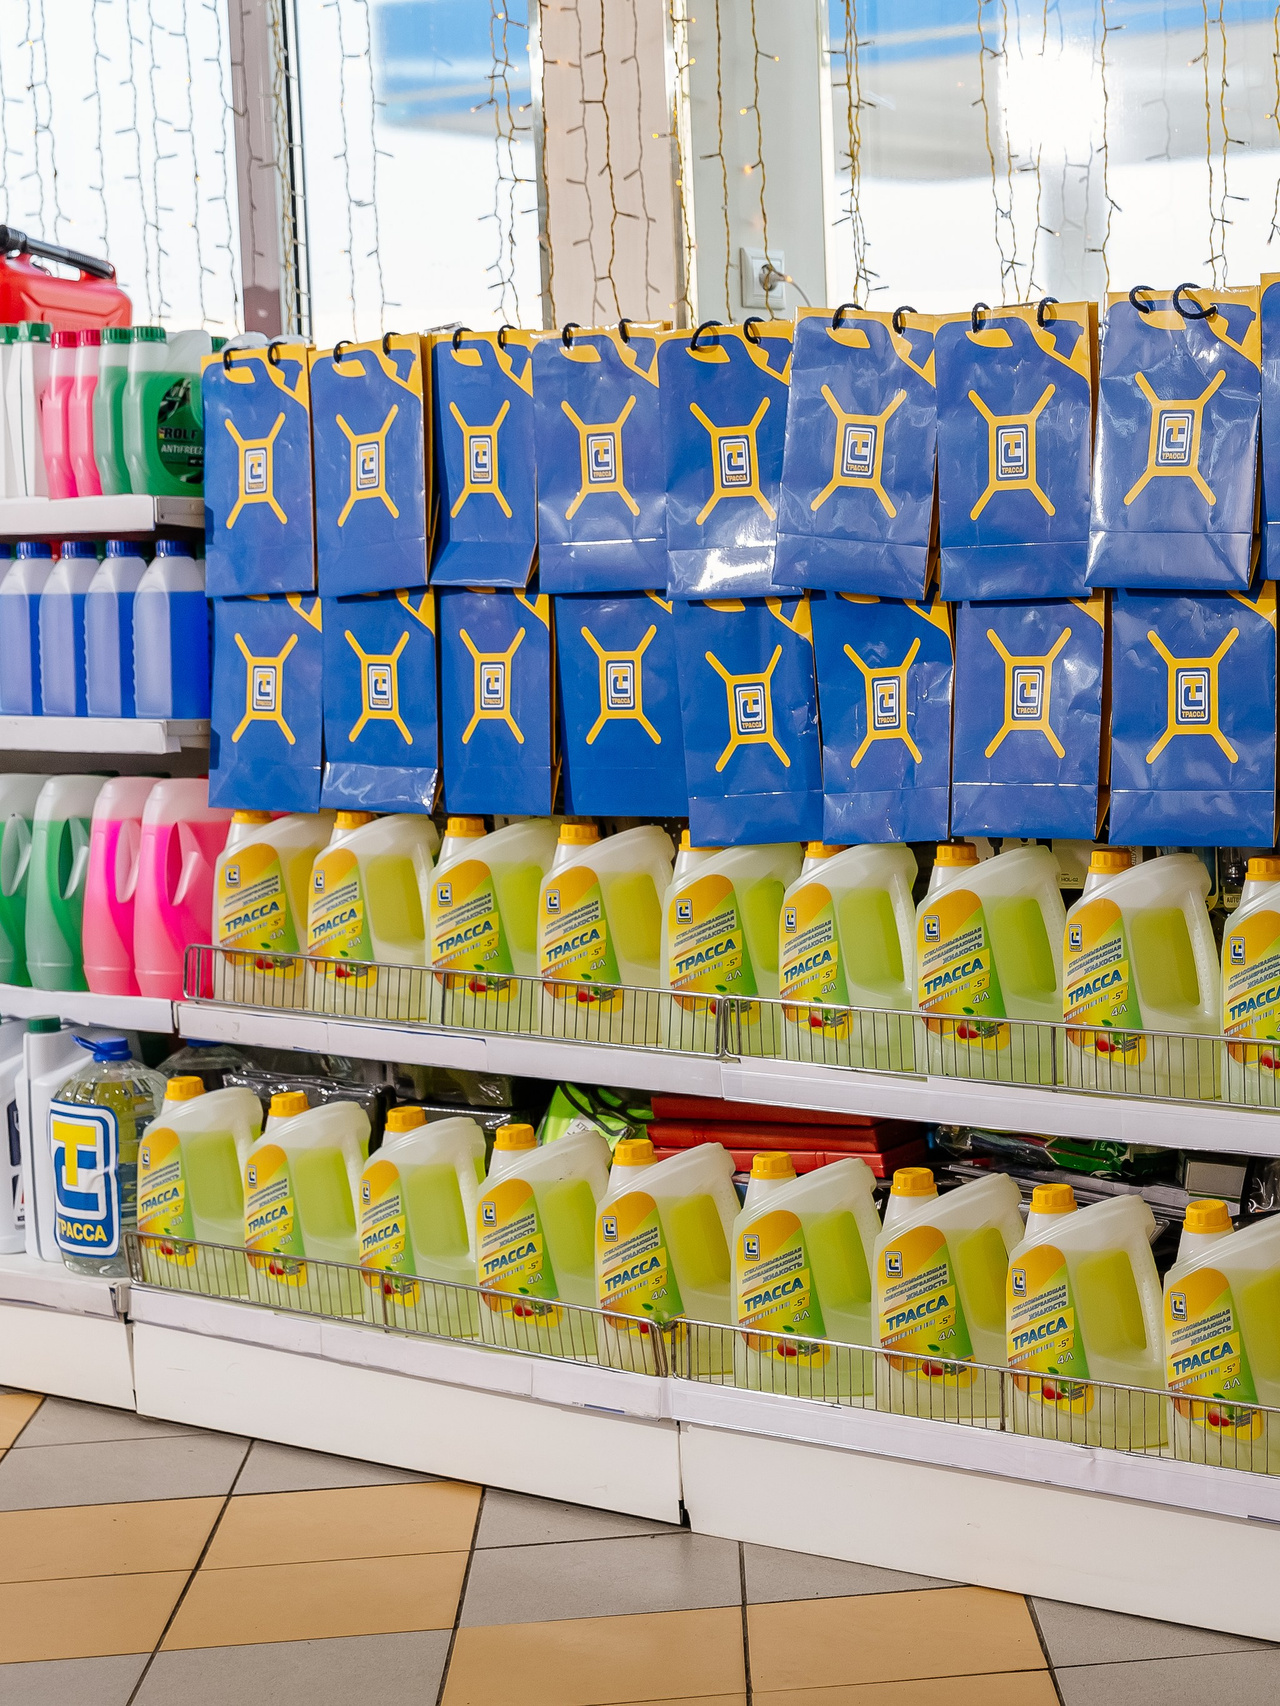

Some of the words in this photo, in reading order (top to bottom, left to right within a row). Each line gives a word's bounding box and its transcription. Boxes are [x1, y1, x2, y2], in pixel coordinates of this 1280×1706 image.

[161, 444, 203, 455] ANTIFREEZ
[847, 464, 868, 472] ТРАССА
[227, 903, 278, 929] ТРАССА
[312, 910, 356, 937] ТРАССА
[439, 922, 491, 951] ТРАССА
[548, 930, 598, 960] ТРАССА
[677, 940, 734, 972] ТРАССА
[785, 951, 831, 978] ТРАССА
[925, 959, 982, 993] ТРАССА
[1069, 970, 1121, 1004] ТРАССА
[144, 1186, 178, 1212] ТРАССА
[247, 1207, 287, 1232] ТРАССА
[361, 1224, 399, 1249] ТРАССА
[485, 1244, 535, 1274] ТРАССА
[606, 1258, 659, 1290] ТРАССА
[745, 1279, 802, 1310] ТРАССА
[887, 1296, 948, 1329] ТРАССА
[1014, 1318, 1067, 1348] ТРАССА
[1174, 1343, 1232, 1373] ТРАССА
